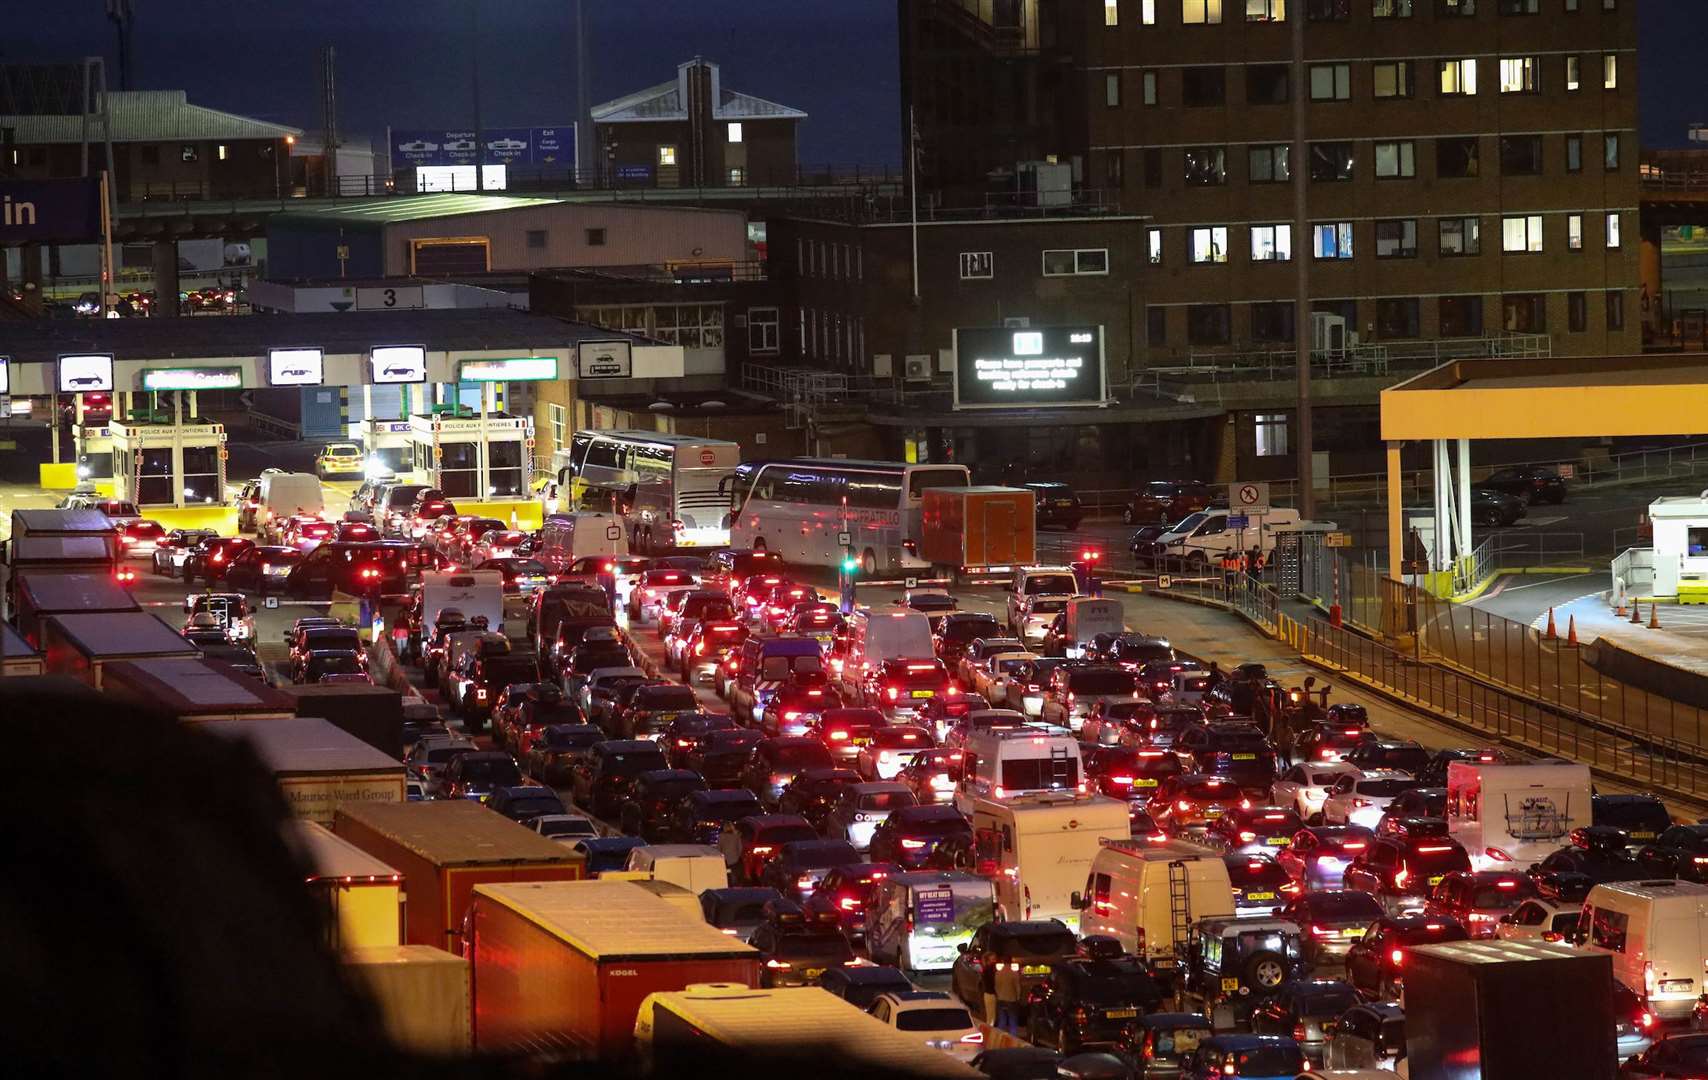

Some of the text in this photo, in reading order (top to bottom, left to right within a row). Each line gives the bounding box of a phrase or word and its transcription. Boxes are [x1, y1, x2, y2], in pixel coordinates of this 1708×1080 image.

[4, 195, 36, 225] in
[383, 288, 397, 307] 3
[1160, 577, 1169, 585] M
[334, 789, 360, 801] Ward
[362, 788, 395, 801] Group
